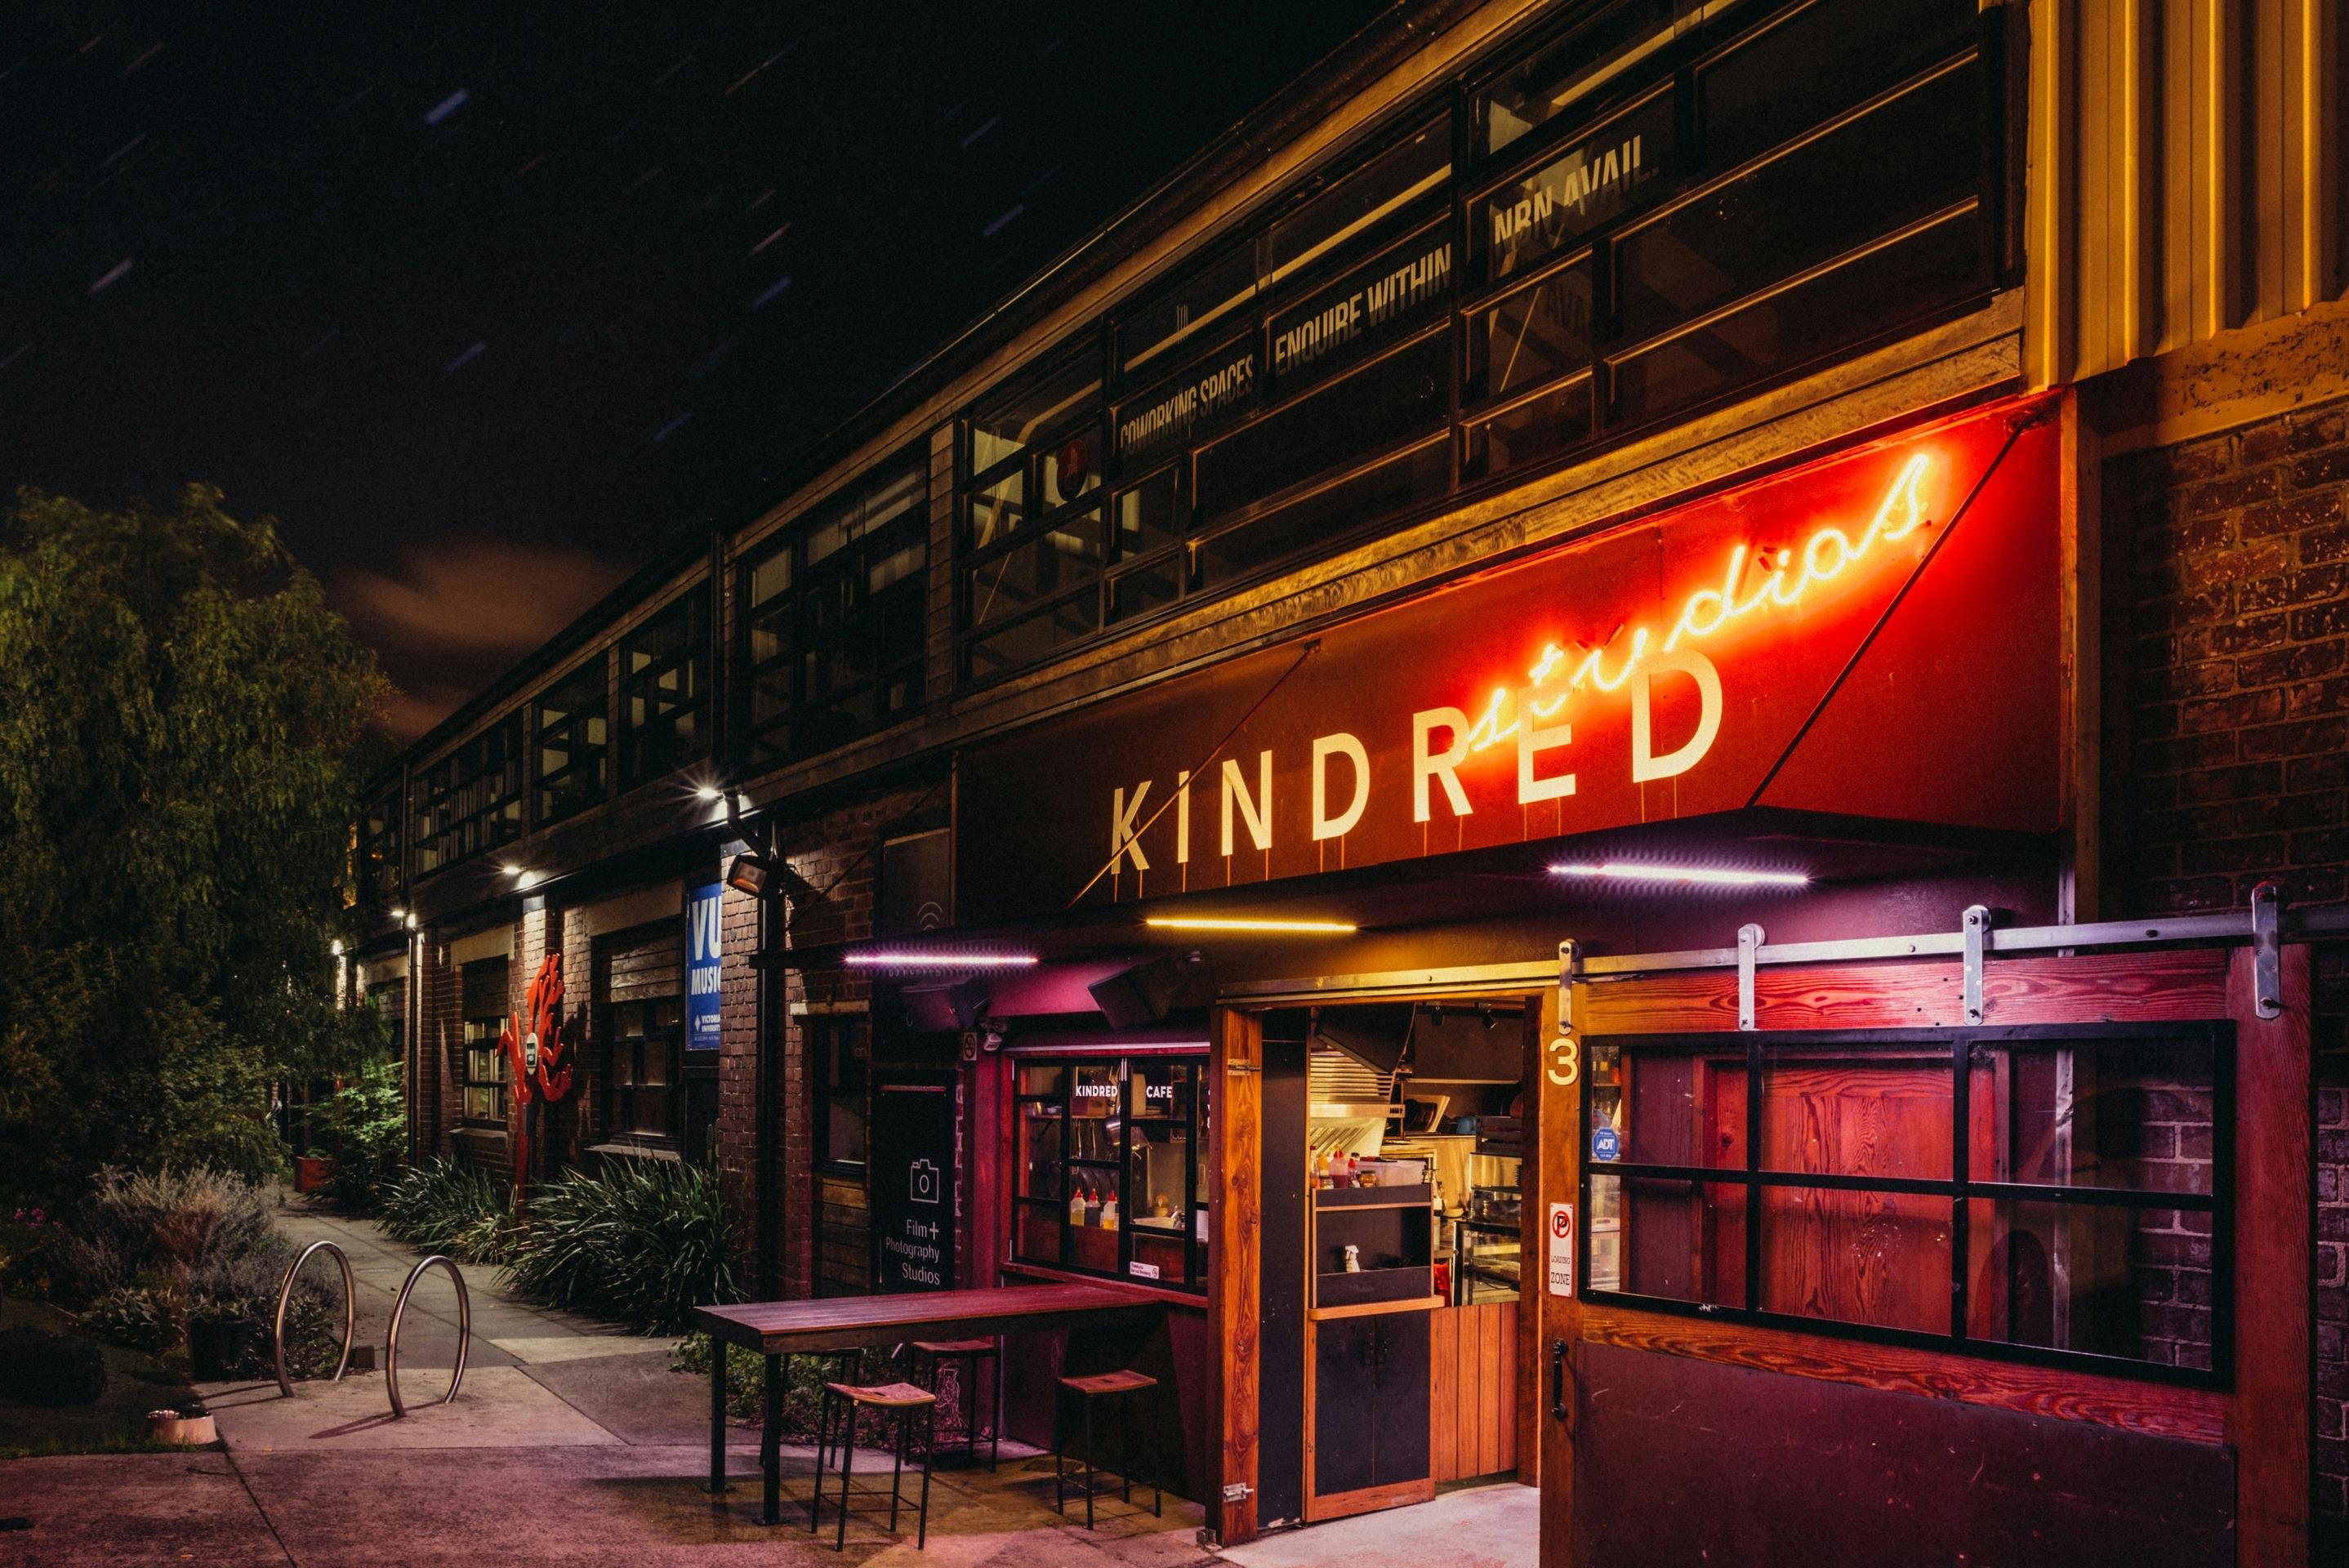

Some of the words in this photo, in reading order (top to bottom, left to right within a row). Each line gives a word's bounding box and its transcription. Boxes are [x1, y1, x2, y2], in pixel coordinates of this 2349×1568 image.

[1495, 185, 1553, 262] NBN
[1275, 292, 1362, 377] ENQUIRE
[1367, 243, 1451, 327] WITHIN
[1120, 385, 1197, 457] COWORKING
[1199, 353, 1254, 417] SPACES
[1469, 452, 1931, 753] studios
[1110, 647, 1723, 875] KINDRED
[692, 896, 722, 960] VU
[1548, 1038, 1578, 1085] 3
[1076, 1085, 1118, 1097] KINDRED
[1147, 1086, 1172, 1098] CAFE
[1597, 1138, 1615, 1150] ADT
[885, 1236, 939, 1263] Photography
[1551, 1255, 1571, 1264] LOADING
[903, 1263, 940, 1285] Studios
[1551, 1272, 1570, 1285] ZONE
